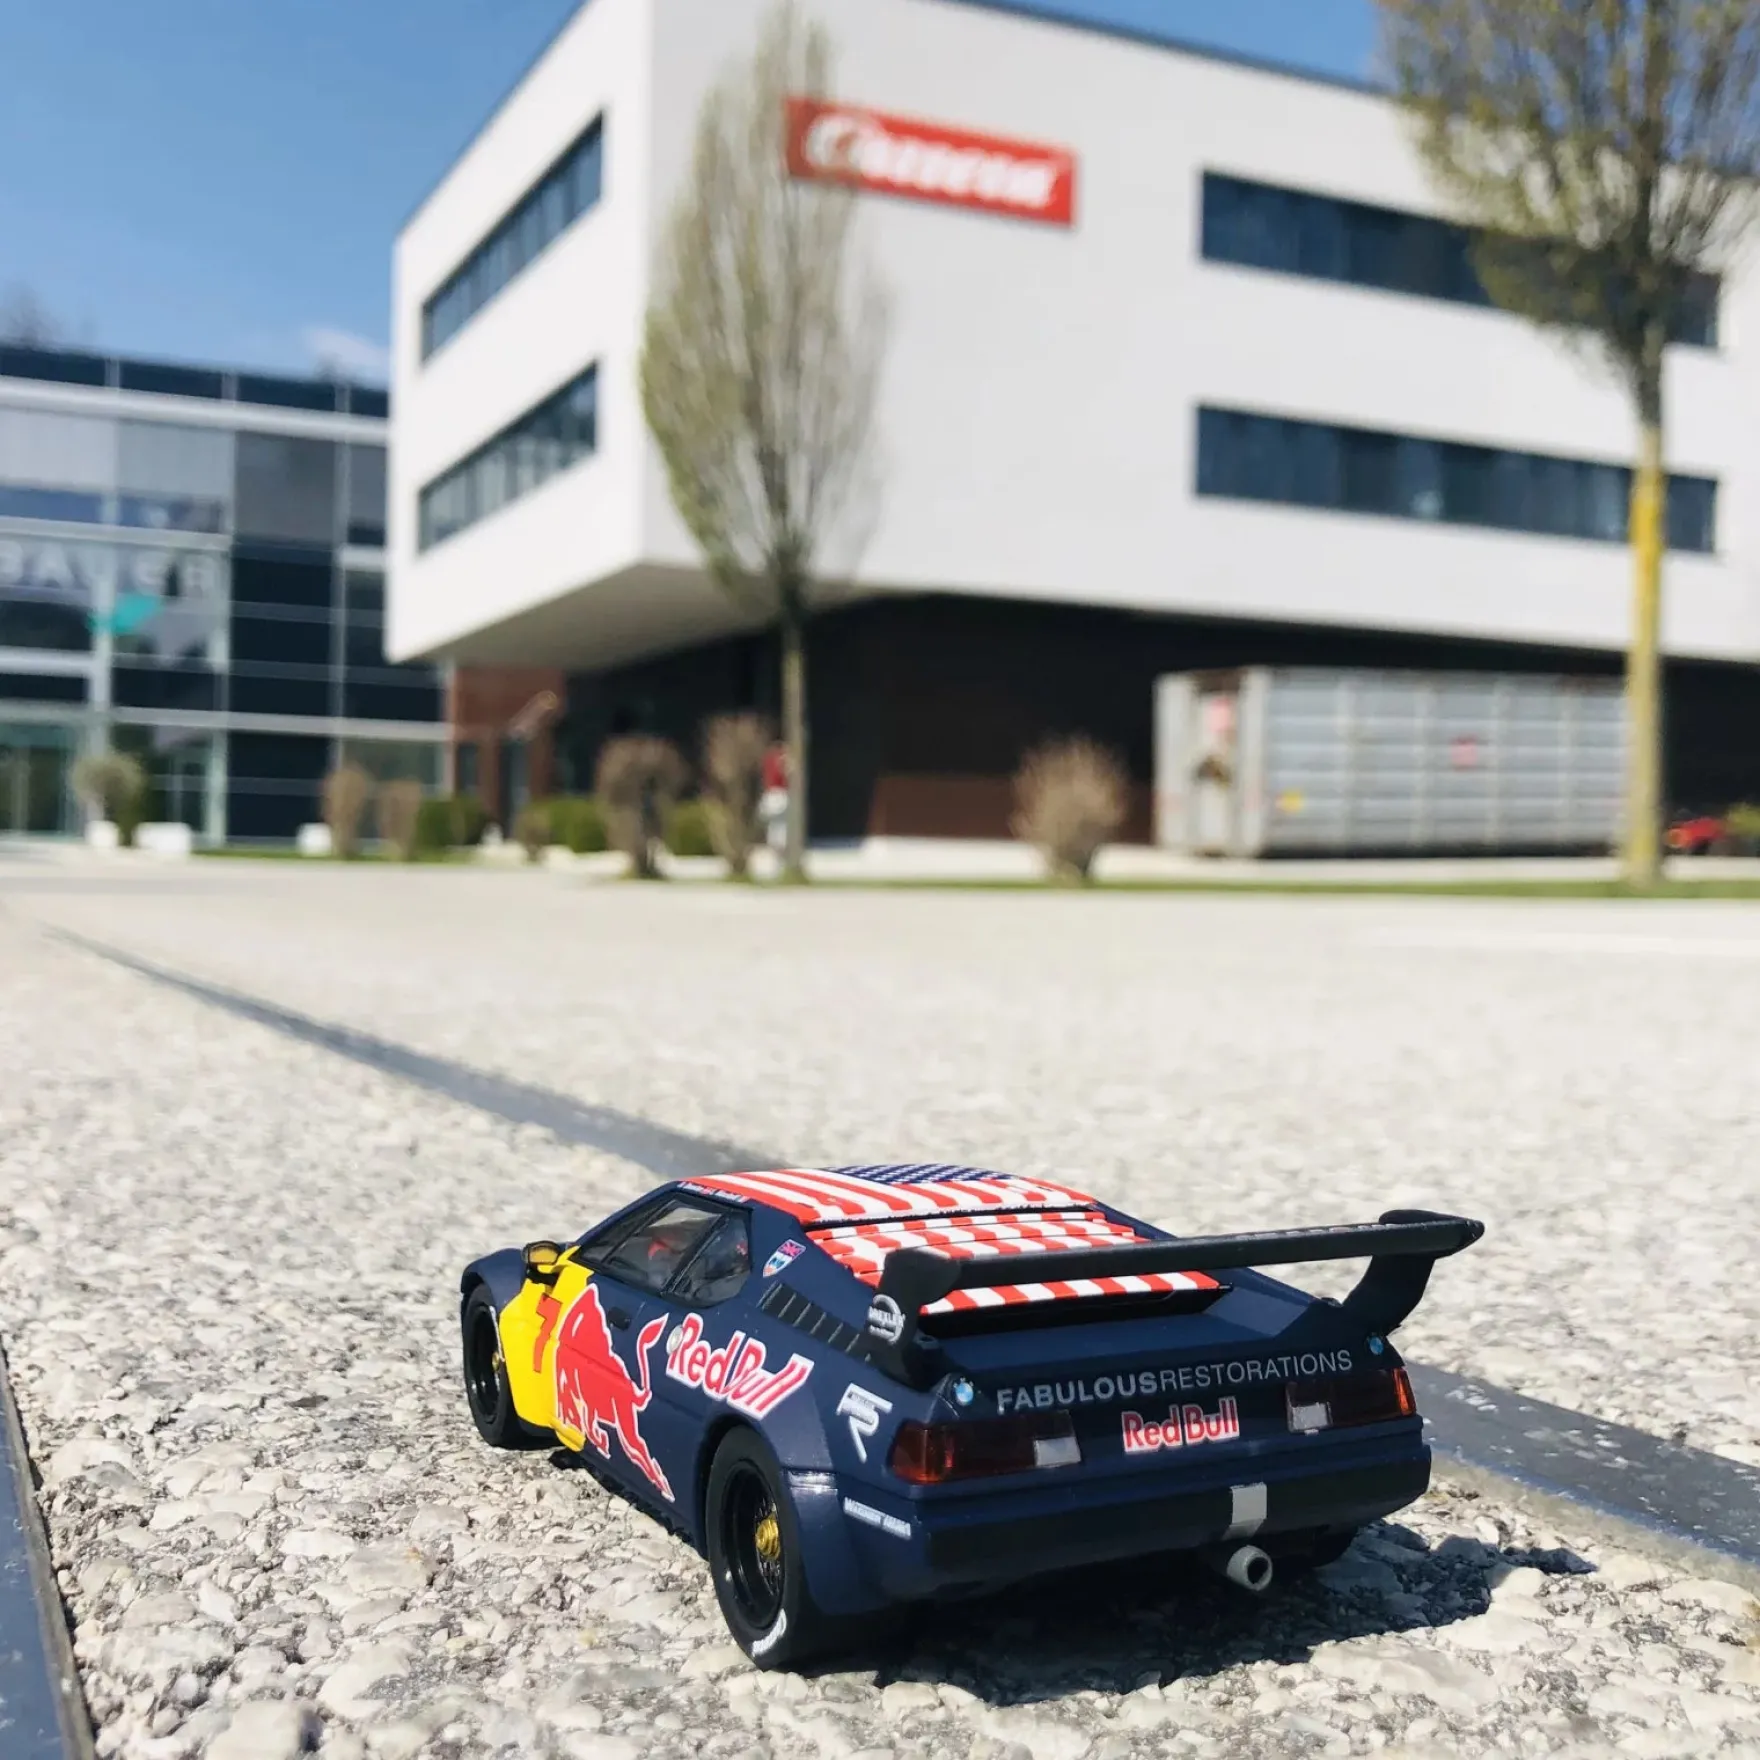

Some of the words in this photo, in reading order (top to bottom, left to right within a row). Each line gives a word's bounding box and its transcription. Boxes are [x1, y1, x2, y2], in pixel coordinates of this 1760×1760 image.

[533, 1292, 563, 1374] 7
[666, 1312, 746, 1402] Red
[721, 1337, 815, 1421] Bull
[1121, 1404, 1181, 1455] Red
[1182, 1395, 1241, 1448] Bull
